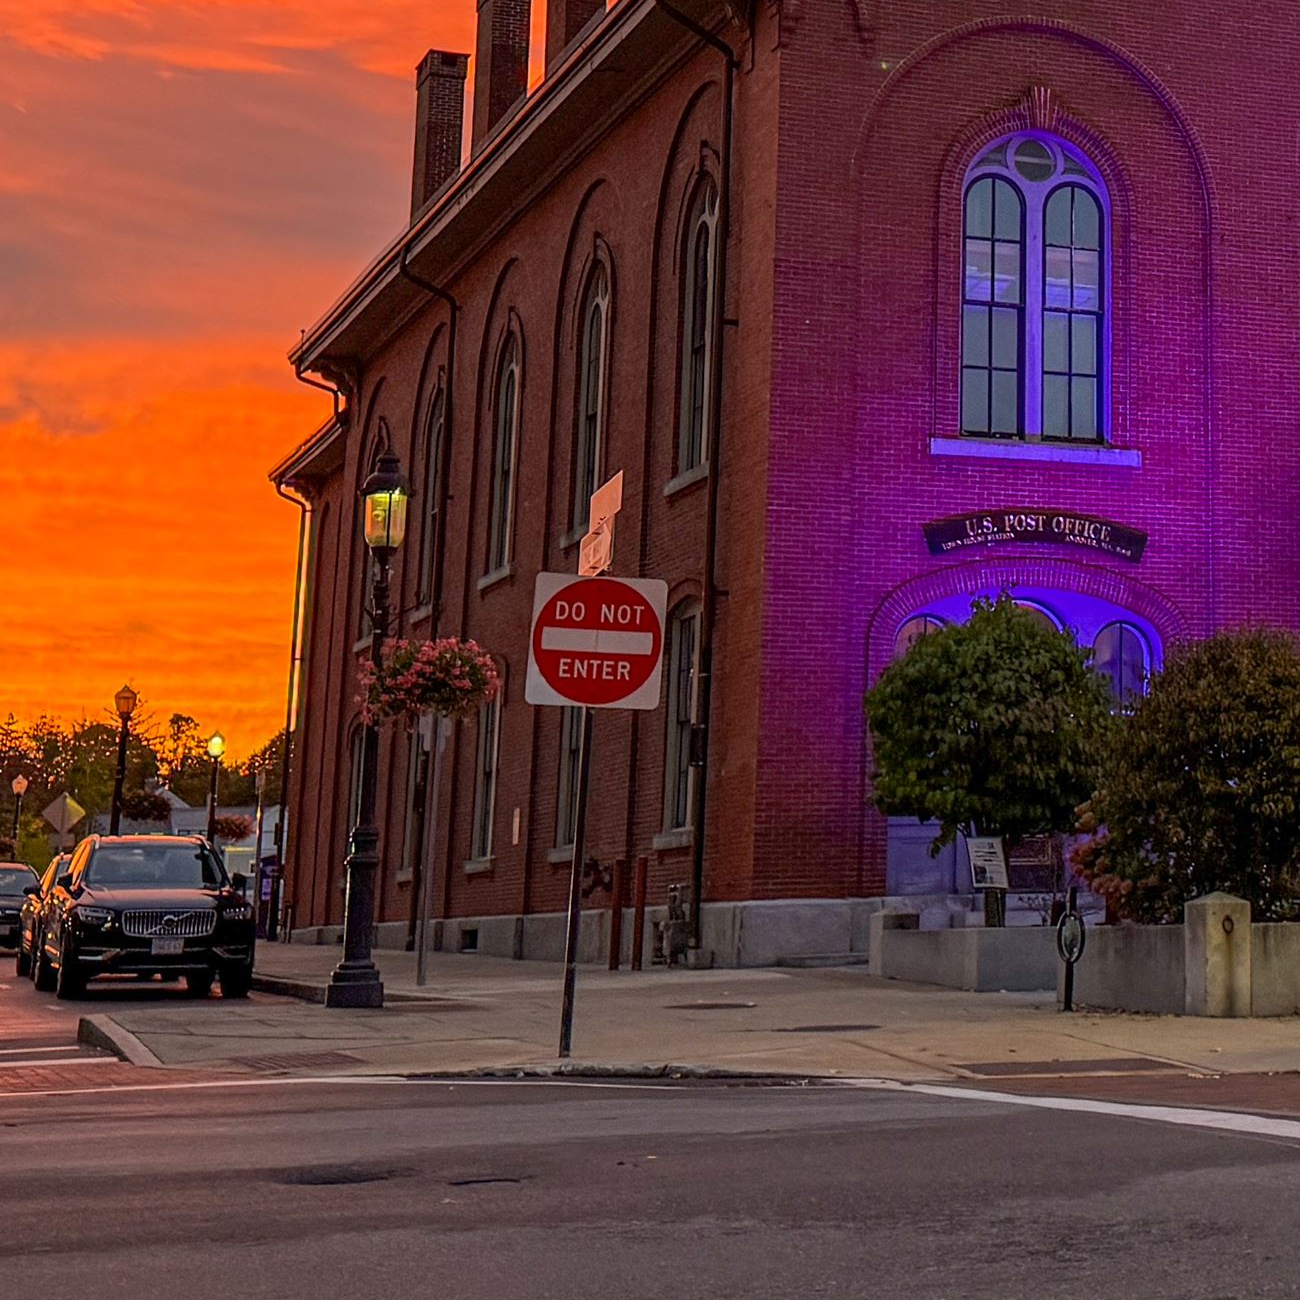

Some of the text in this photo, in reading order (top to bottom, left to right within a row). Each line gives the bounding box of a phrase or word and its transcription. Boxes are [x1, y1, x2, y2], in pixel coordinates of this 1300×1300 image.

[966, 514, 1111, 542] U.S. POST OFFICE
[555, 601, 645, 625] DO NOT
[558, 658, 630, 681] ENTER
